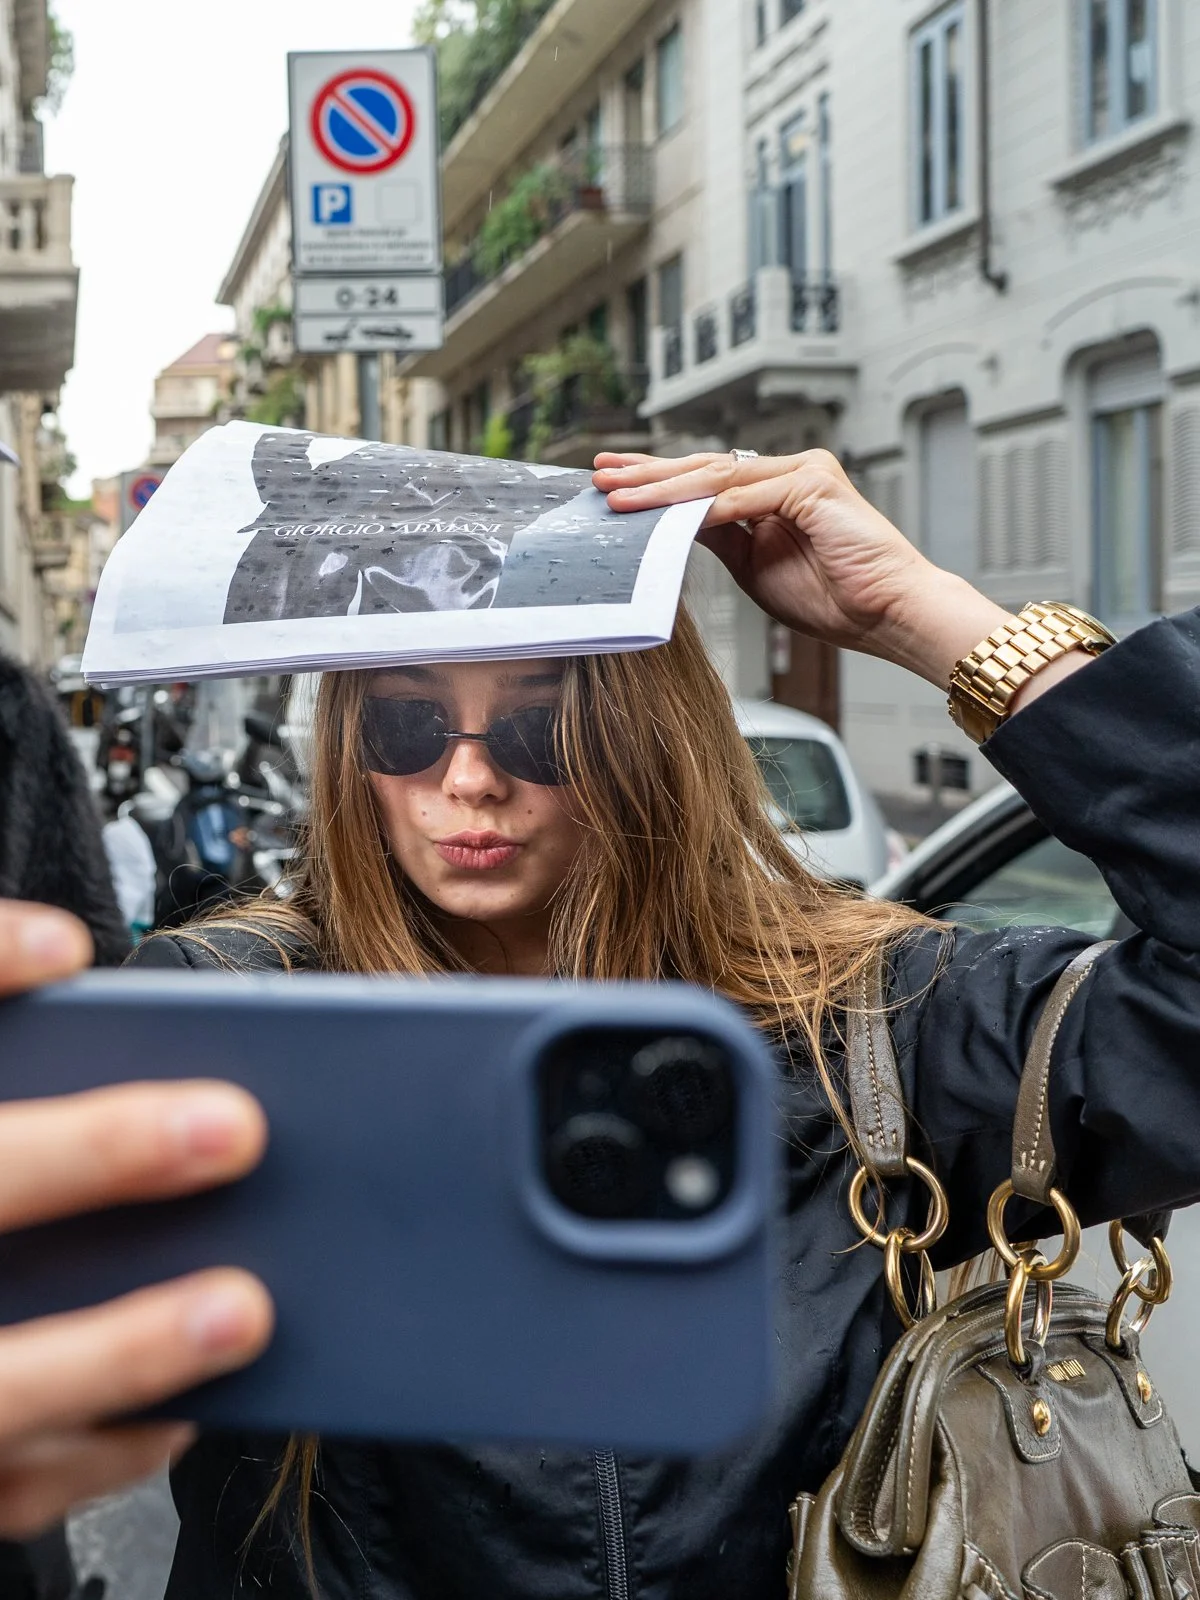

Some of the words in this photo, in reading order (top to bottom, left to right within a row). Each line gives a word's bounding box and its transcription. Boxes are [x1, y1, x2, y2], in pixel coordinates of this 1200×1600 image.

[320, 188, 347, 222] P
[273, 522, 385, 537] GIORGIO
[391, 522, 504, 535] ARMANI
